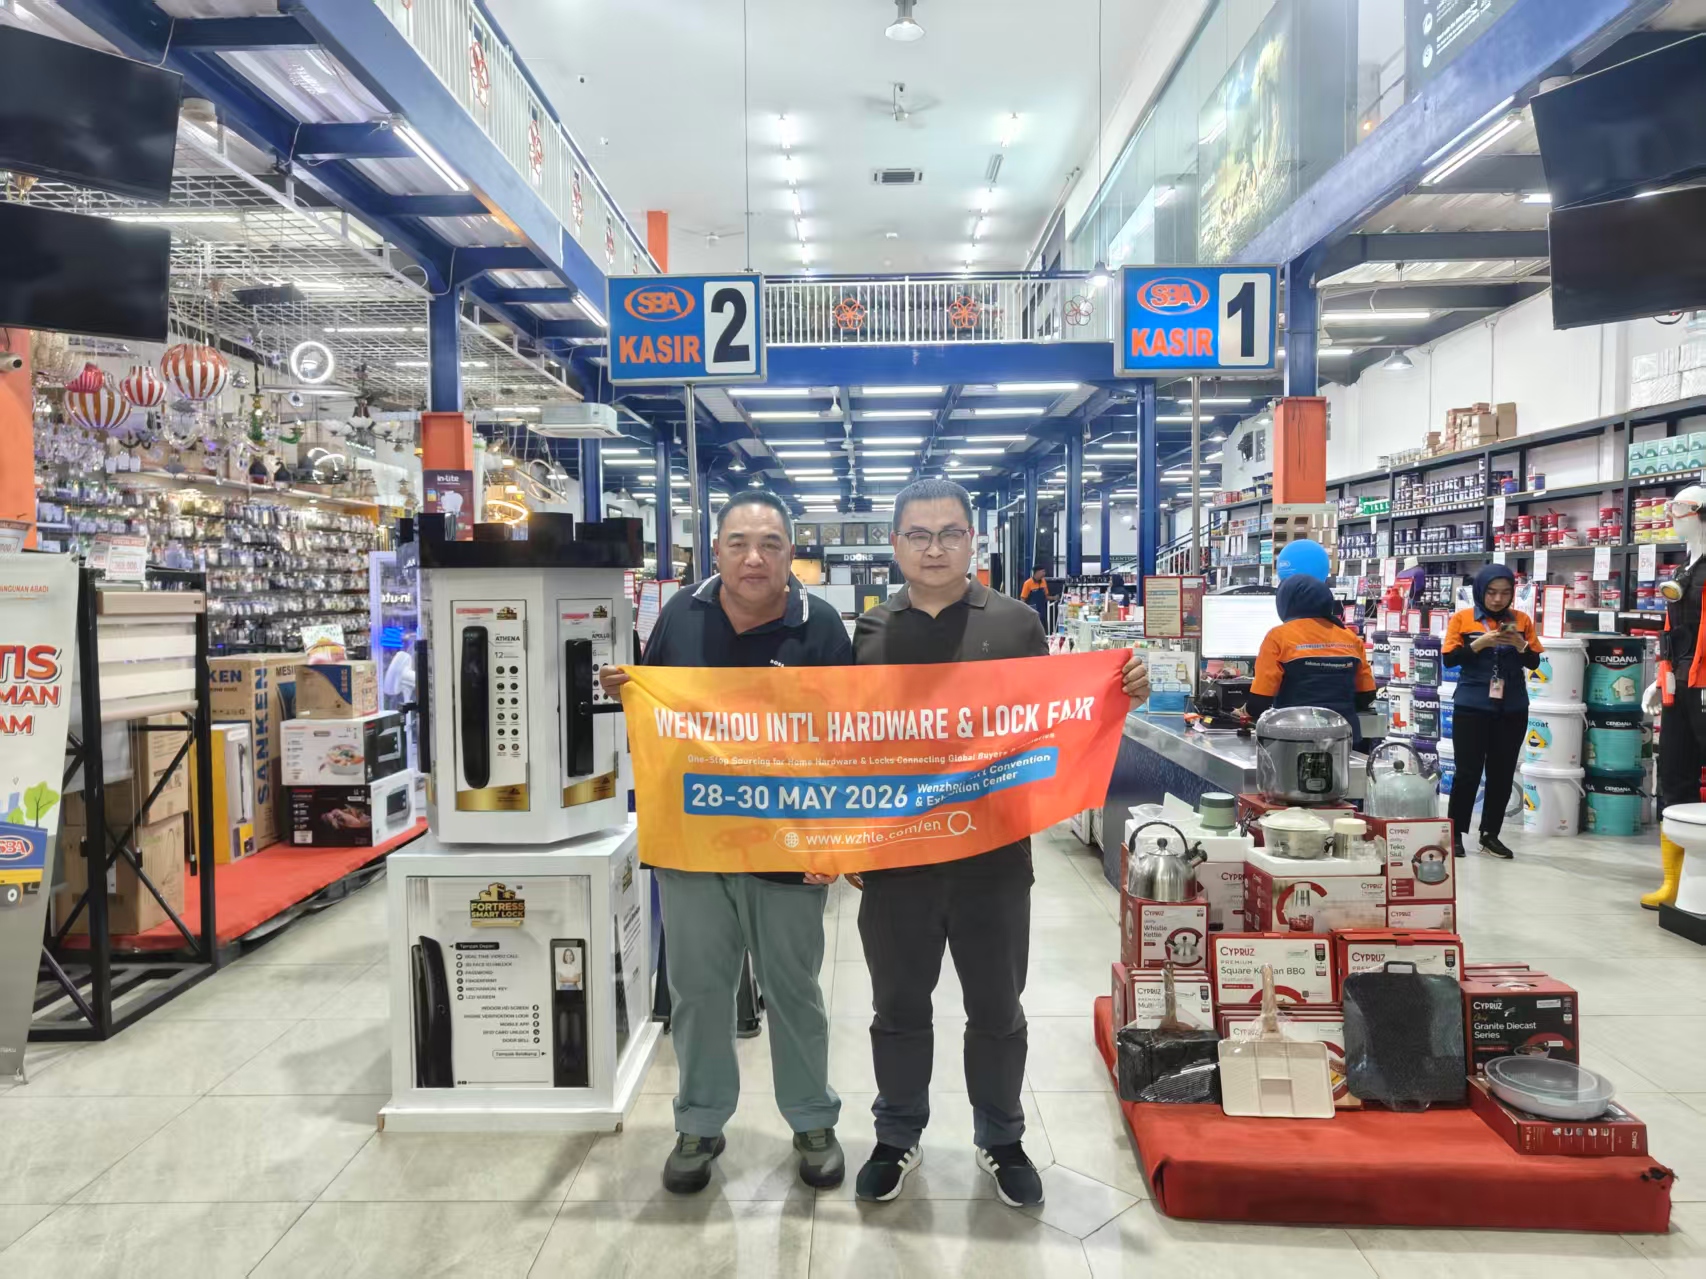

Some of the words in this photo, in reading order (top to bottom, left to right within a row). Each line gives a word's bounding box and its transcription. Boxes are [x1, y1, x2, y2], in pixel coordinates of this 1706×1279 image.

[637, 291, 683, 314] SBA
[1151, 284, 1197, 307] SBA
[711, 287, 750, 363] 2
[1227, 282, 1256, 358] 1
[619, 335, 702, 364] KASIR
[1131, 328, 1214, 357] KASIR
[495, 651, 504, 659] 12
[1595, 655, 1638, 663] CENDANA
[653, 707, 760, 742] WENZHOU
[766, 711, 820, 743] INT'L
[827, 708, 949, 743] HARDWARE
[956, 707, 975, 738] &
[982, 703, 1040, 738] LOCK
[1047, 696, 1095, 729] FAIR
[255, 667, 270, 805] SANKEN
[731, 756, 771, 767] Sourcing
[788, 758, 812, 767] Home
[815, 757, 858, 766] Hardware
[860, 757, 868, 765] &
[869, 756, 894, 765] Locks
[896, 755, 946, 765] Connecting
[949, 751, 976, 763] Global
[989, 753, 1051, 775] Convention
[690, 783, 769, 810] 28-30
[778, 785, 838, 810] MAY
[844, 784, 909, 809] 2026
[915, 796, 923, 808] &
[983, 771, 1018, 788] Center
[805, 819, 941, 846] www.wzhle.com/en
[471, 902, 525, 911] FORTRESS
[1220, 946, 1256, 957] CYPRUZ
[1352, 952, 1386, 962] CYPRUZ
[1220, 966, 1252, 976] Square
[1286, 967, 1306, 975] BBQ
[1473, 1001, 1503, 1010] CYPRUZ
[1474, 1022, 1505, 1030] Granite
[1506, 1021, 1537, 1030] Diecast
[1474, 1031, 1501, 1039] Series
